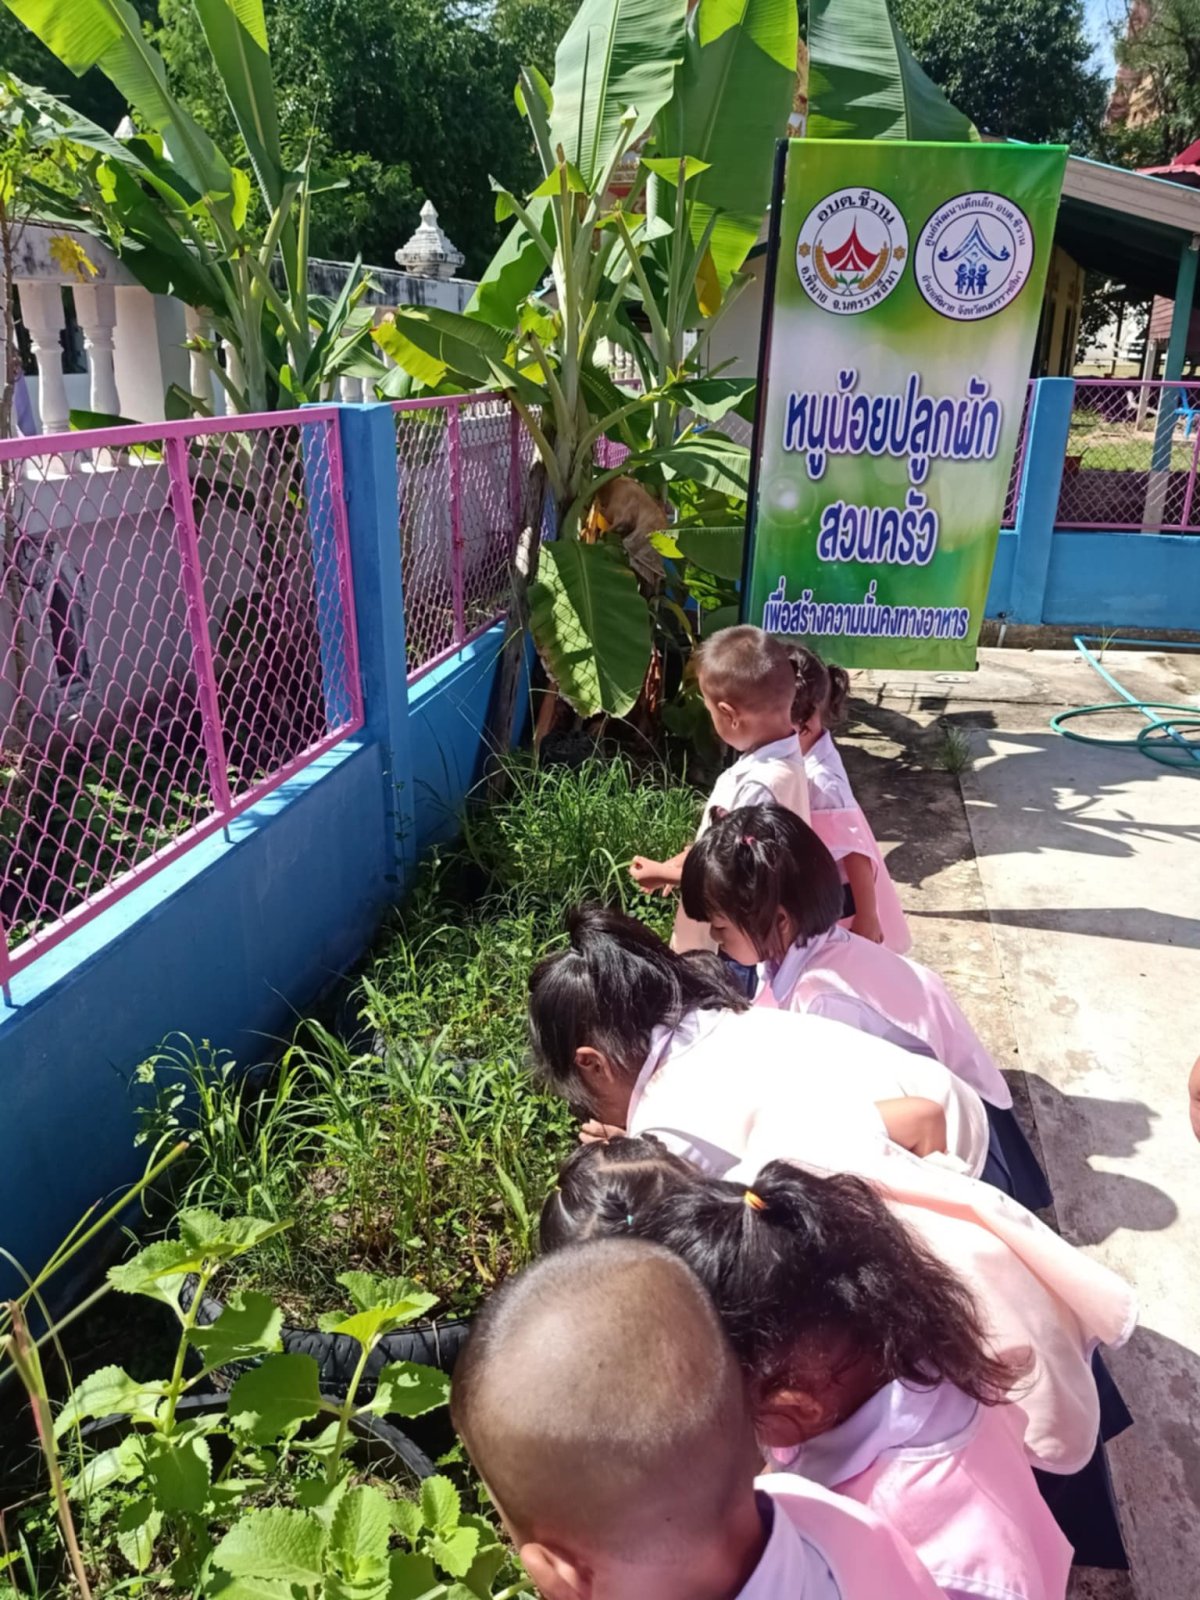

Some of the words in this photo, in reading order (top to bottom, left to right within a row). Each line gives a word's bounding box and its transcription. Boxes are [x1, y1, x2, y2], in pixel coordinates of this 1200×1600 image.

[800, 265, 829, 304] อ.พิมาย
[783, 368, 1003, 484] หนูน้อยปลูกผัก
[817, 487, 938, 565] สวนครัว
[763, 575, 970, 639] เพื่อสร้างความมั่นคงทางอาหาร
